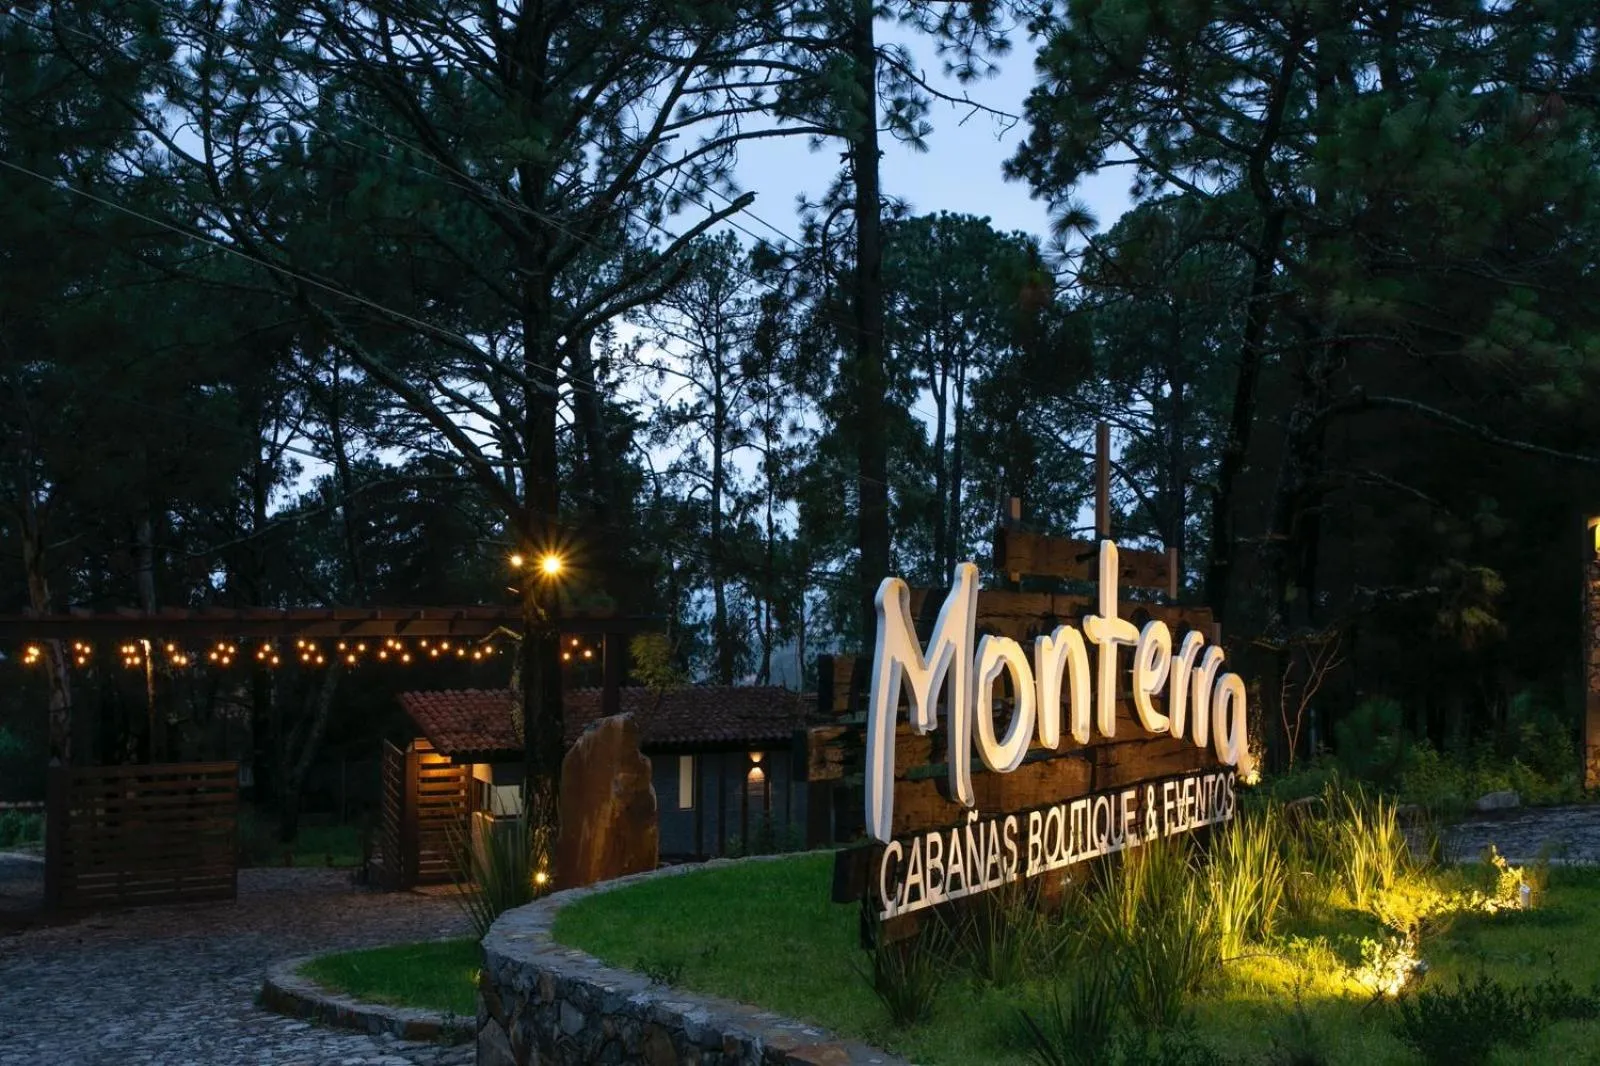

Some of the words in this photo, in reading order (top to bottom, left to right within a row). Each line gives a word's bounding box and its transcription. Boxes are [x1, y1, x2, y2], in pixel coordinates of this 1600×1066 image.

[865, 539, 1255, 844] Monterra
[880, 809, 1017, 917] CABAÑAS
[1027, 790, 1137, 872] BOUTIQUE
[1145, 785, 1158, 839] &
[1163, 772, 1235, 834] EVENTOS
